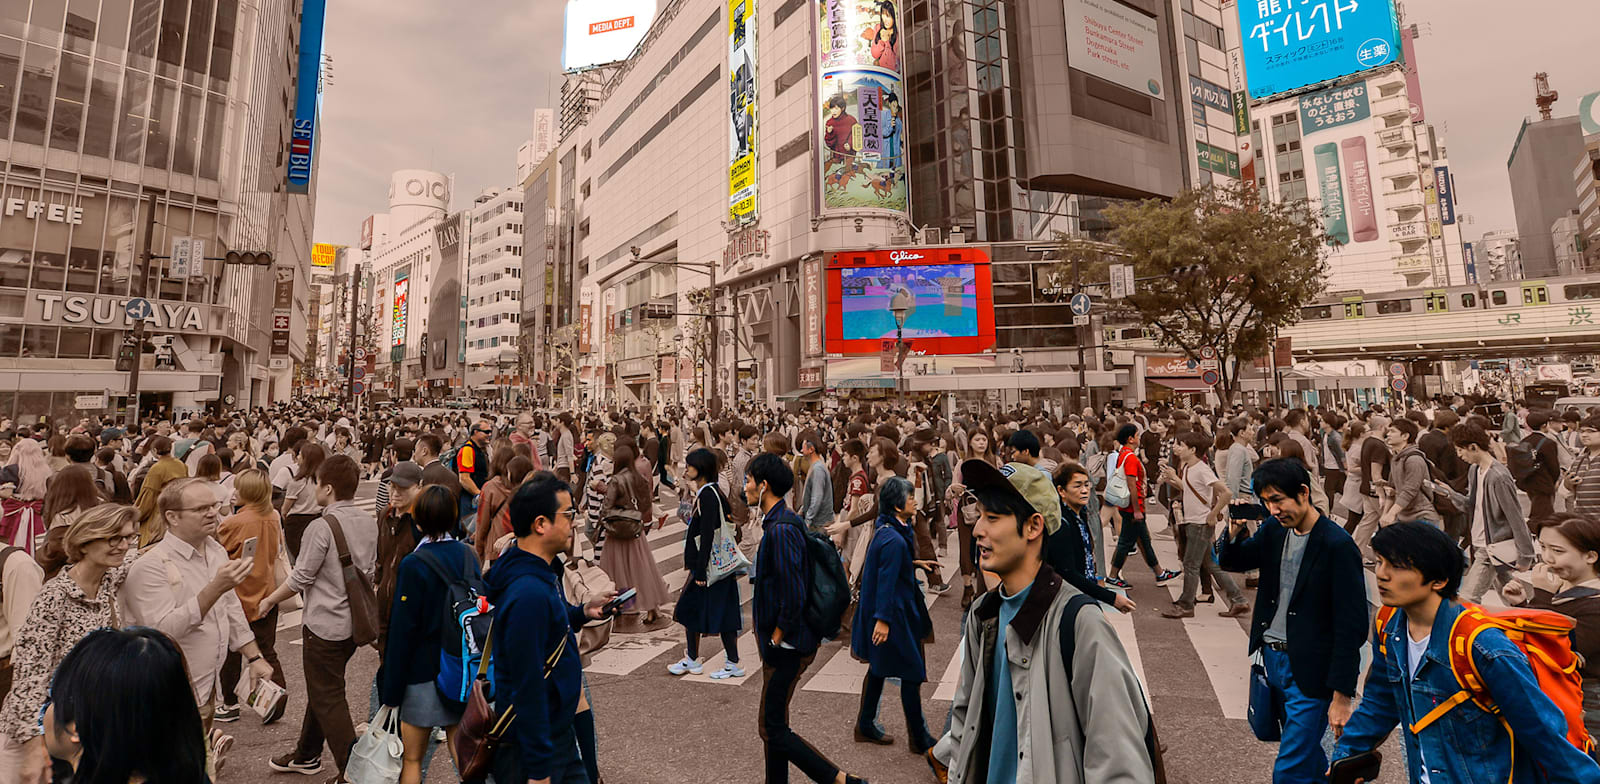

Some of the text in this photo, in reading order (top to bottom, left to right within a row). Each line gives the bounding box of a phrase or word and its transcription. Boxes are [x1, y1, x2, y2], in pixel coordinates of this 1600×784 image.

[592, 18, 632, 33] MEDIA DEPT.
[1084, 15, 1144, 47] Shibuya Center Street
[1085, 26, 1135, 53] Bunkamura Street
[1087, 47, 1101, 59] Park
[1358, 43, 1388, 62] 生薬
[1302, 86, 1364, 109] 水なしで飲む
[1315, 109, 1356, 127] うるおう
[723, 229, 769, 272] MAGNET
[890, 250, 924, 264] Glico
[37, 294, 203, 330] TSUTAYA
[1498, 313, 1521, 324] JR
[1568, 306, 1594, 326] 渋
